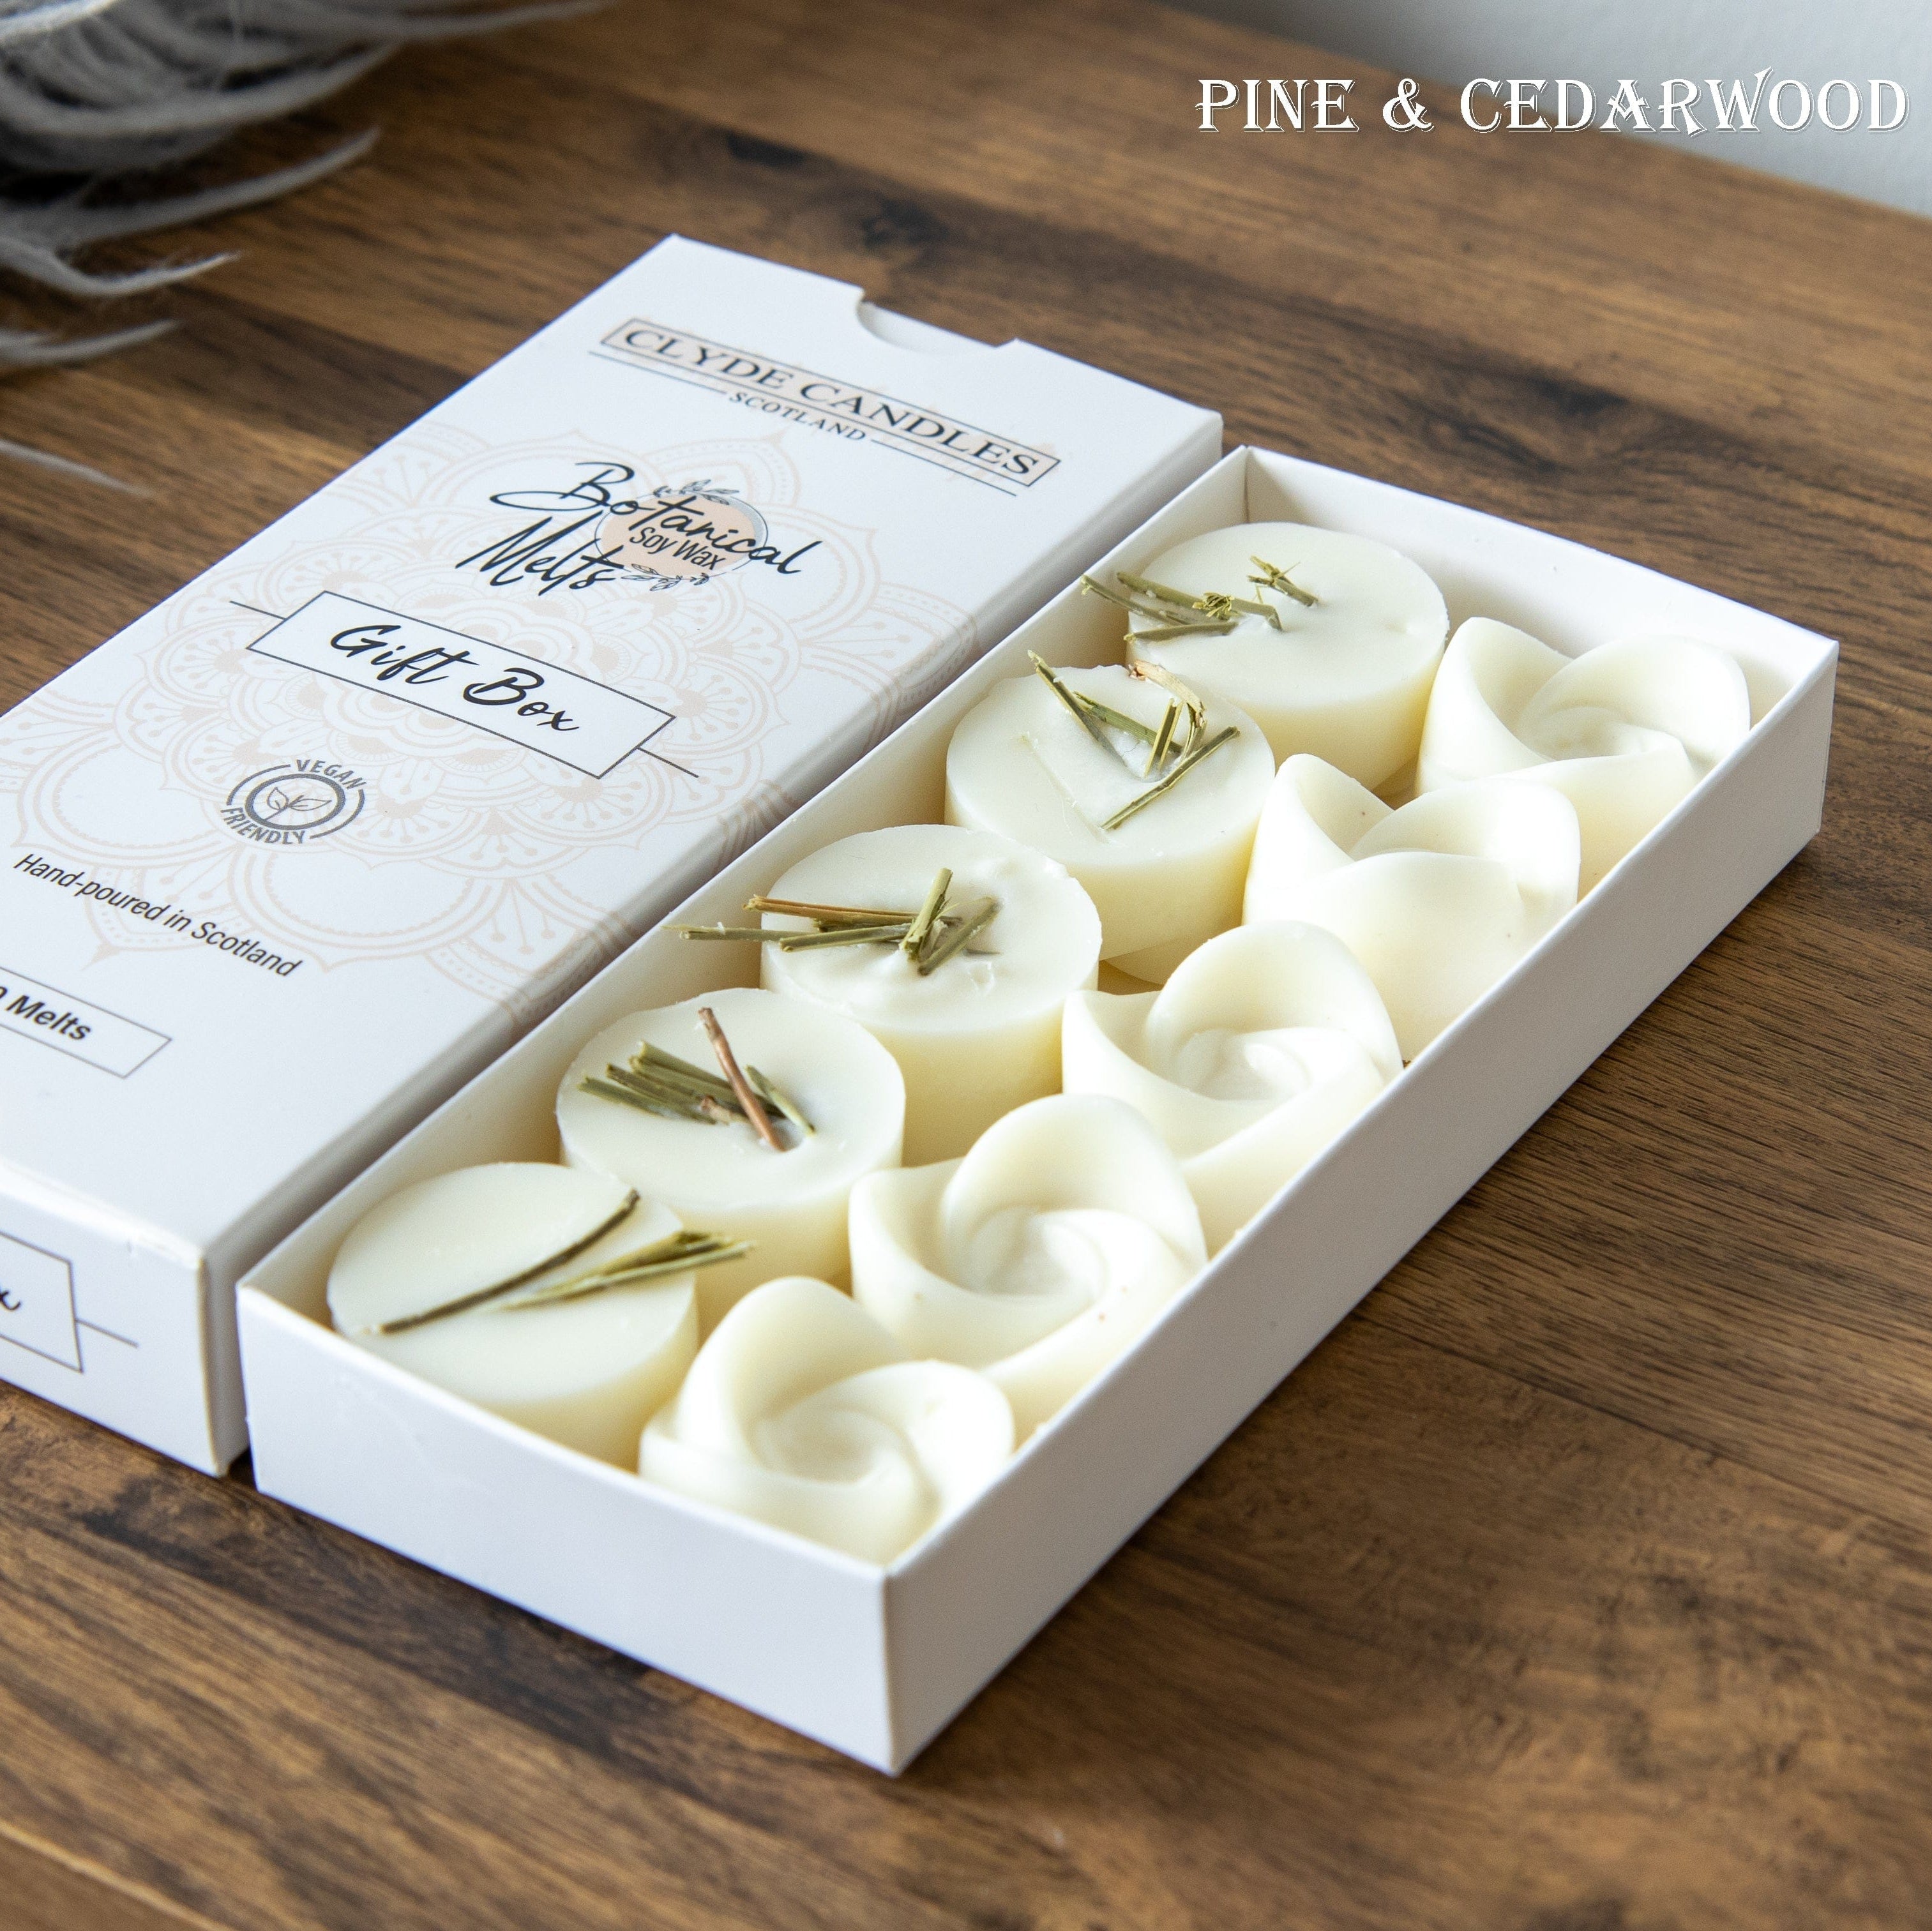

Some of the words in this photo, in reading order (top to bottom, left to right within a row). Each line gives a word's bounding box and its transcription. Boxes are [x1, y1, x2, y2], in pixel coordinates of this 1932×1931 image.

[624, 329, 795, 389] CLYDE
[800, 382, 1039, 477] CANDLES
[729, 391, 866, 440] SCOTLAND
[489, 461, 822, 575] Botanical
[630, 527, 678, 554] Soy
[672, 540, 726, 570] Wax
[455, 509, 624, 596] Melts
[330, 624, 479, 685] Gift
[462, 667, 580, 732] Box
[296, 759, 367, 790] VEGAN
[220, 807, 305, 845] FRIENDLY
[13, 853, 170, 920] Hand-poured
[163, 910, 192, 932] in
[192, 922, 303, 977] Scotland
[6, 995, 92, 1041] Melts
